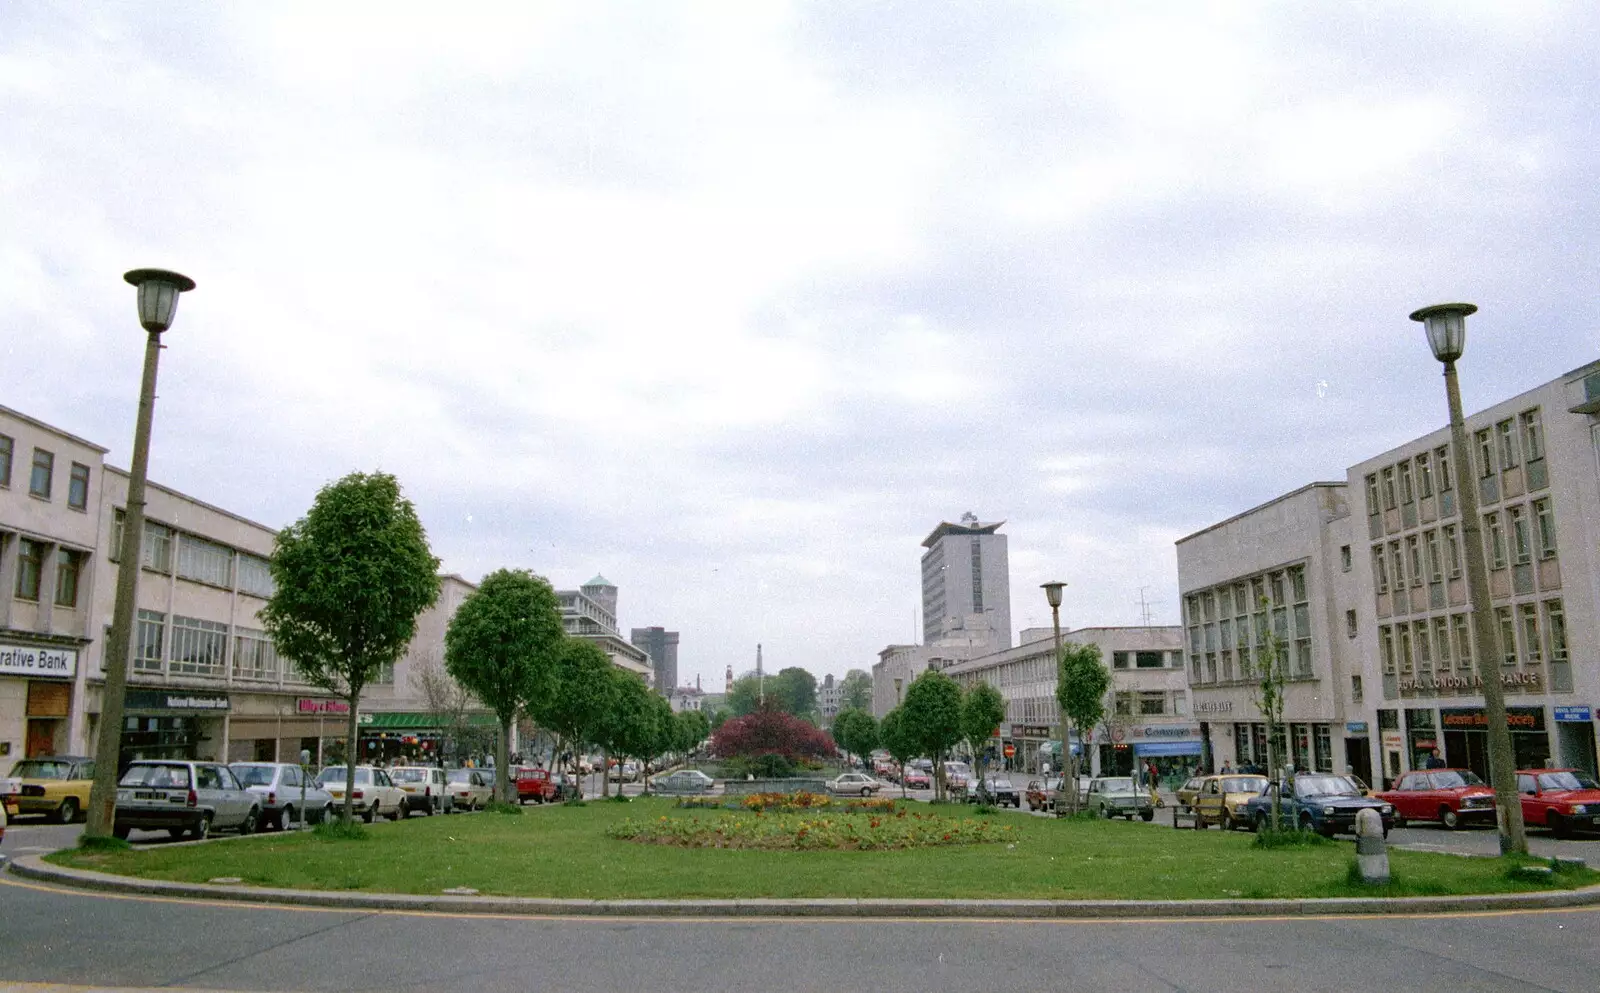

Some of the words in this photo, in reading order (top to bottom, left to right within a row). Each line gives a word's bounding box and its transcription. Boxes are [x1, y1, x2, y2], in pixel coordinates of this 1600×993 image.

[0, 648, 34, 667] rative
[39, 651, 67, 670] Bank
[1399, 679, 1424, 690] ROYAL
[1429, 676, 1468, 688] LONDON
[1471, 672, 1537, 687] INRANCE
